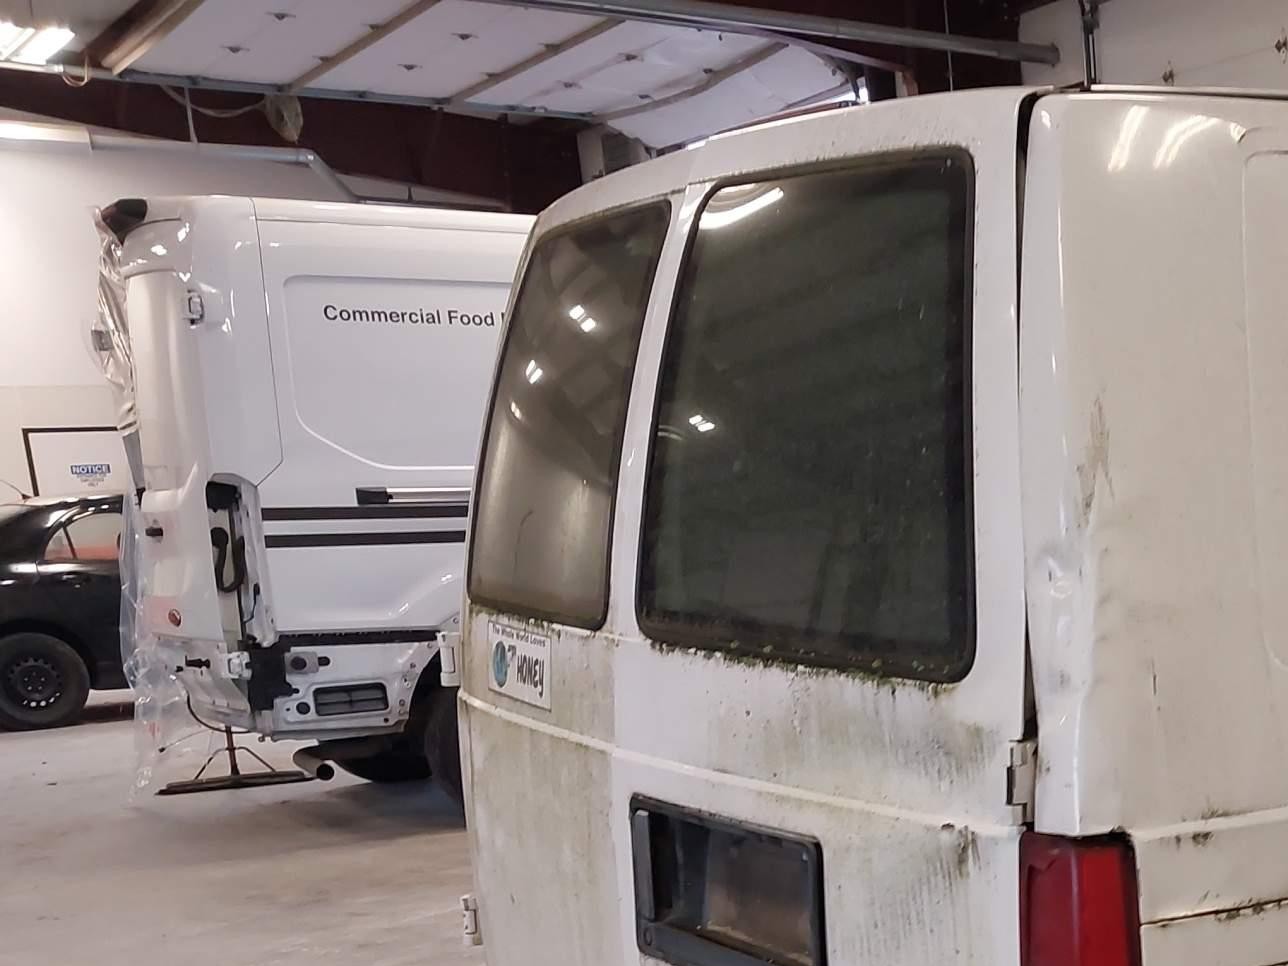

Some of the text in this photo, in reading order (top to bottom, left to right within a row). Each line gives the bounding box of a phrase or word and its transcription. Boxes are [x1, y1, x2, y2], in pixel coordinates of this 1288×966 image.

[323, 304, 441, 325] Commercial
[448, 309, 495, 327] Food
[72, 464, 109, 475] NOTICE
[516, 653, 546, 699] HONEY
